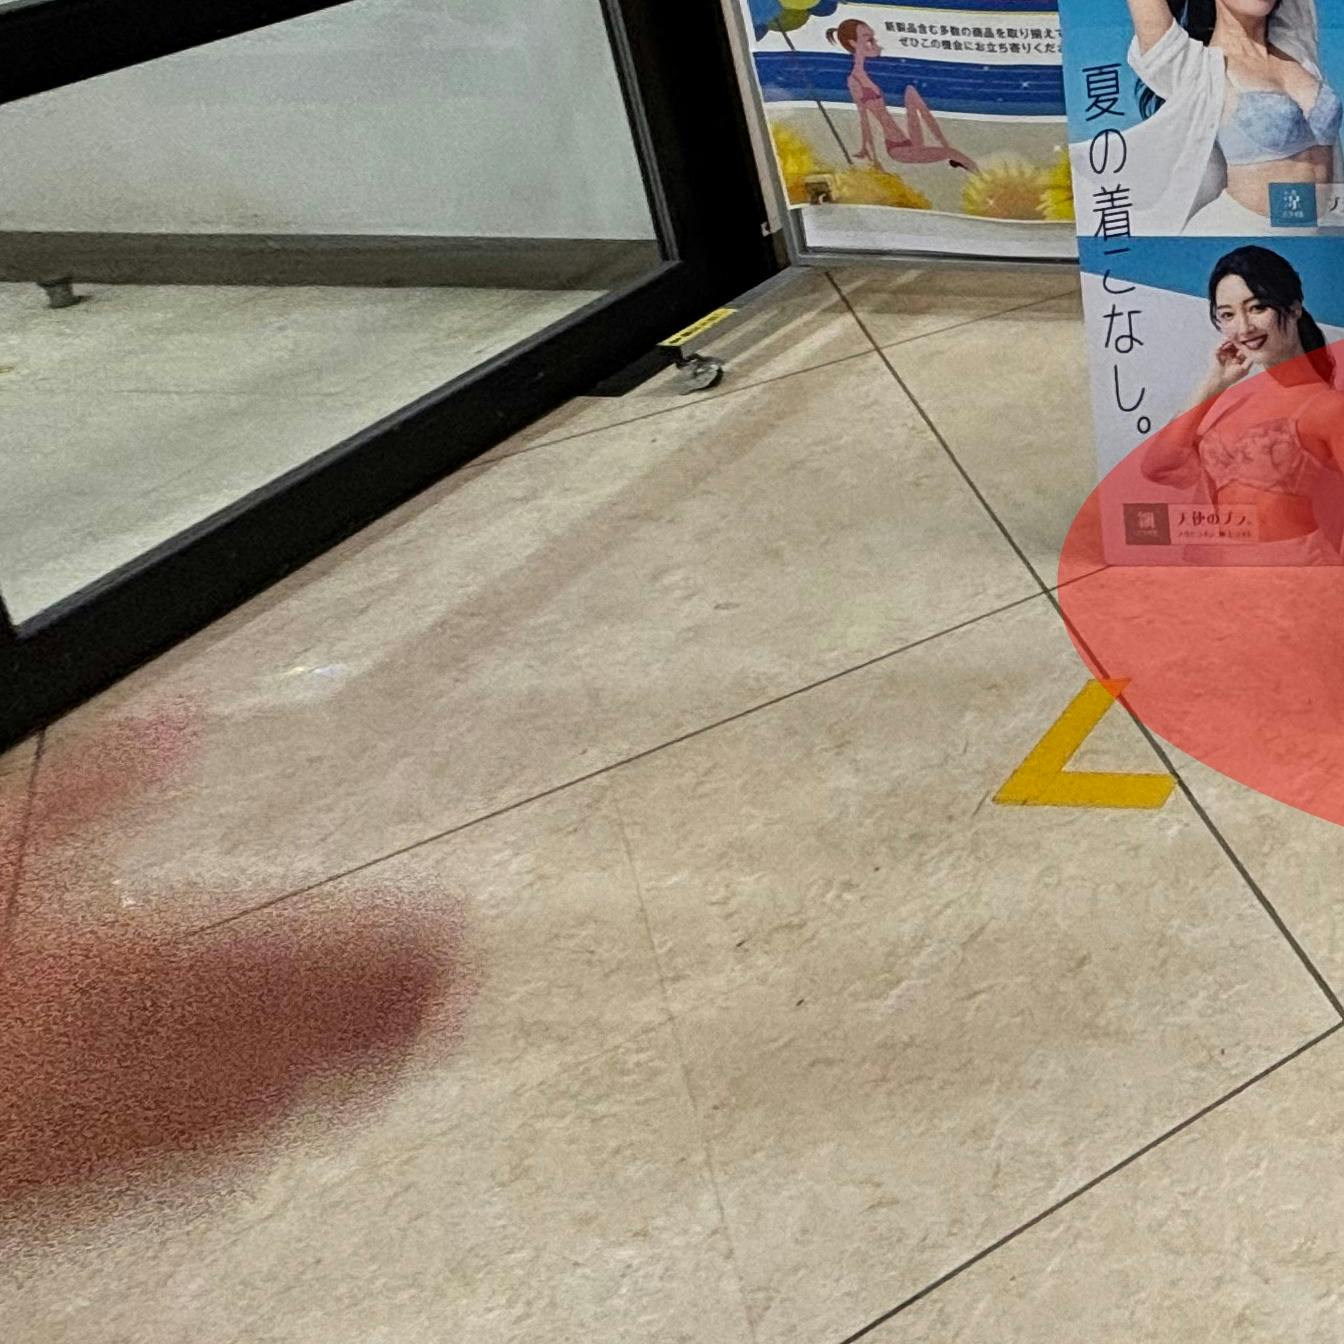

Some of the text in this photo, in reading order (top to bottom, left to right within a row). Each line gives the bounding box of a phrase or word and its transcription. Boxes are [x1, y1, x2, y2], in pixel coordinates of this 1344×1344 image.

[1082, 63, 1151, 434] 夏の着こなし。
